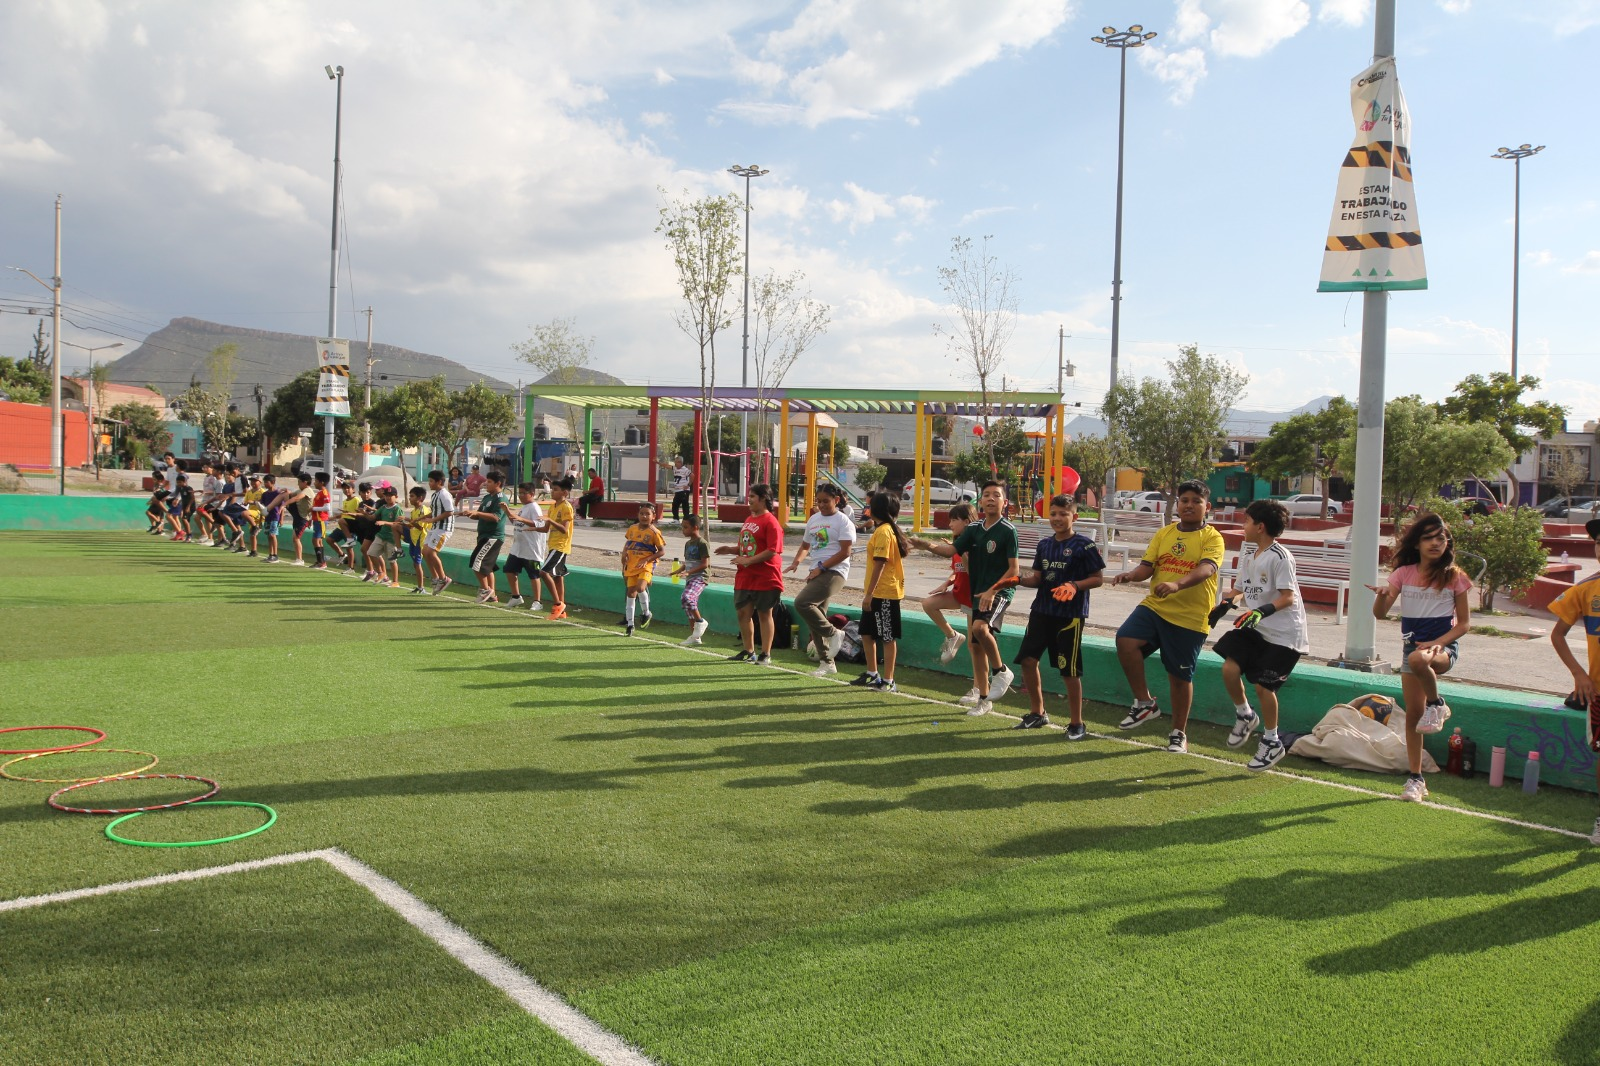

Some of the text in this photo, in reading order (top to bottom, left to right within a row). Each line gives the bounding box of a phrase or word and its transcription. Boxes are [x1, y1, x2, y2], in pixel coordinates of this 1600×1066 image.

[1341, 212, 1355, 220] EN
[1356, 209, 1380, 219] ESTA
[1050, 561, 1067, 569] AT&T
[874, 611, 882, 636] adidas
